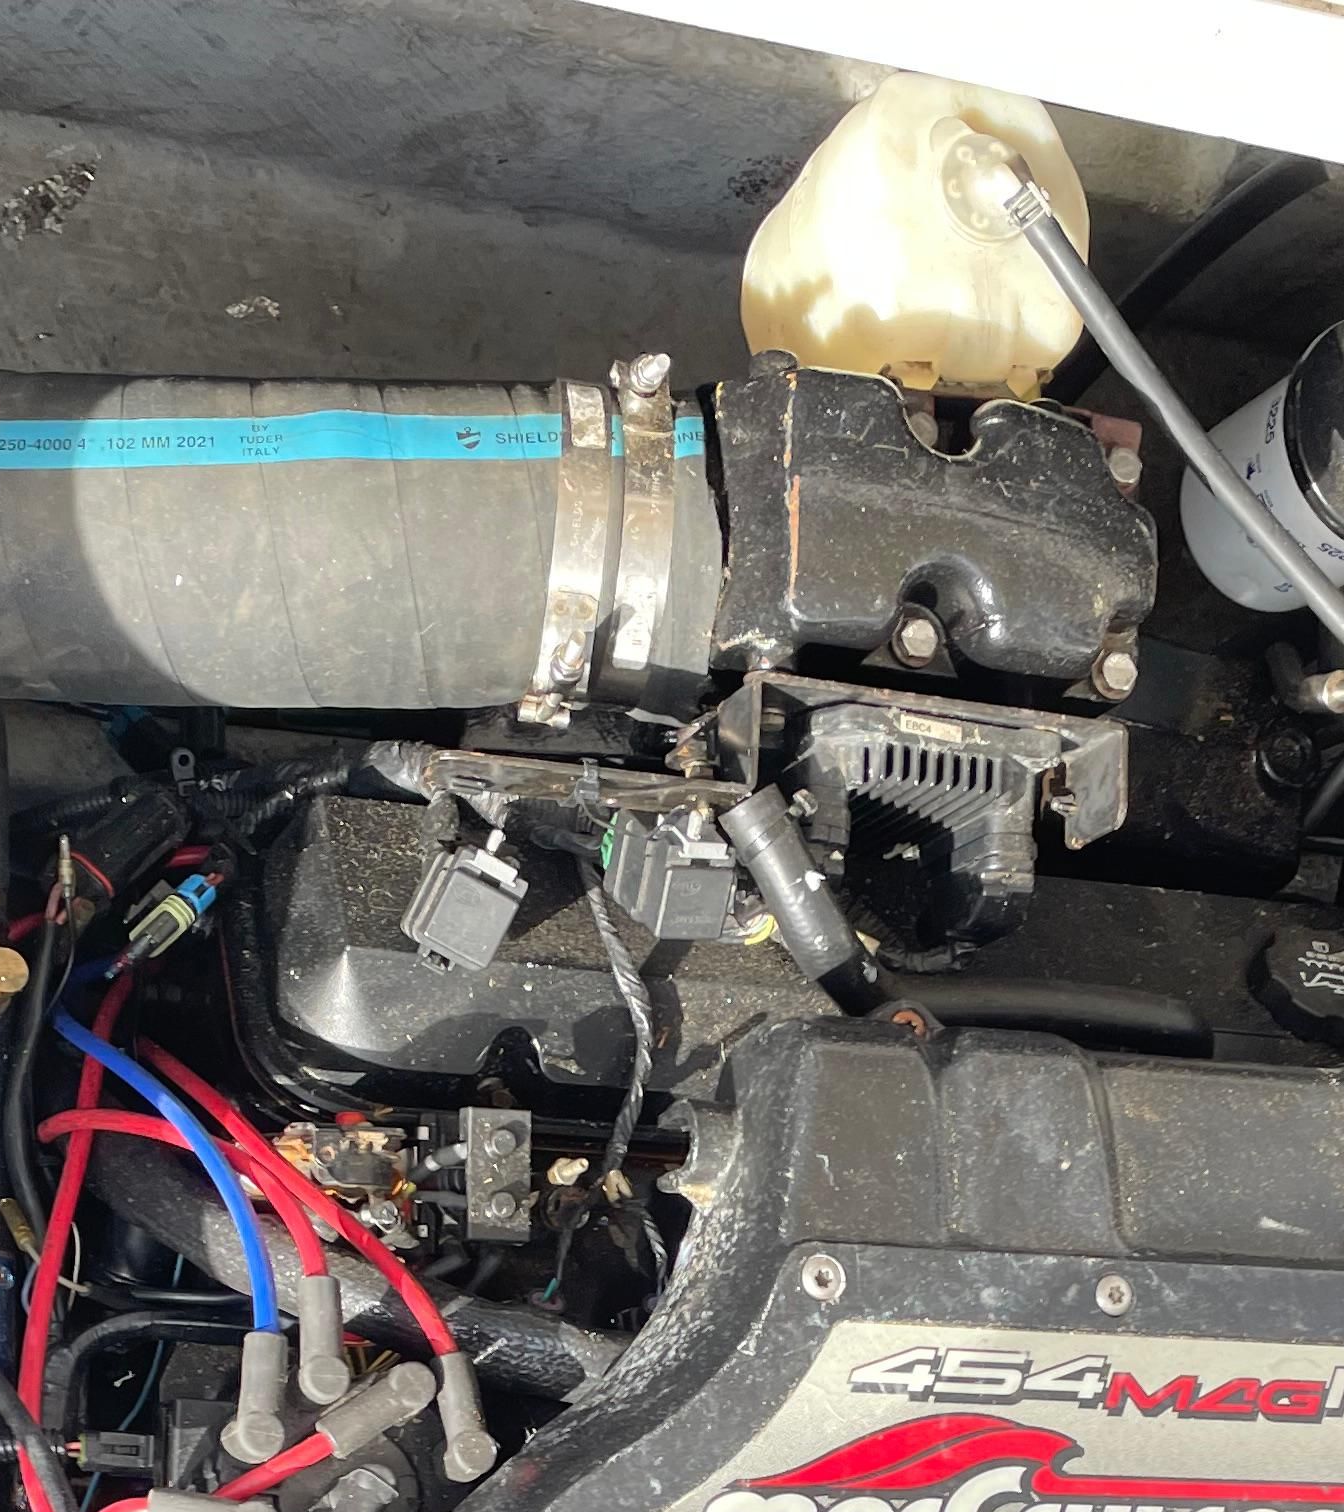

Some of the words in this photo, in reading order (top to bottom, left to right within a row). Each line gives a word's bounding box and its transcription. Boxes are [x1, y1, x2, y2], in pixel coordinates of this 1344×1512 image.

[251, 423, 270, 433] BY
[141, 436, 171, 449] MM
[175, 435, 216, 449] 2021
[239, 433, 284, 445] TUDER
[242, 446, 280, 457] ITALY
[846, 1346, 1113, 1409] 454
[1104, 1371, 1328, 1425] MAG
